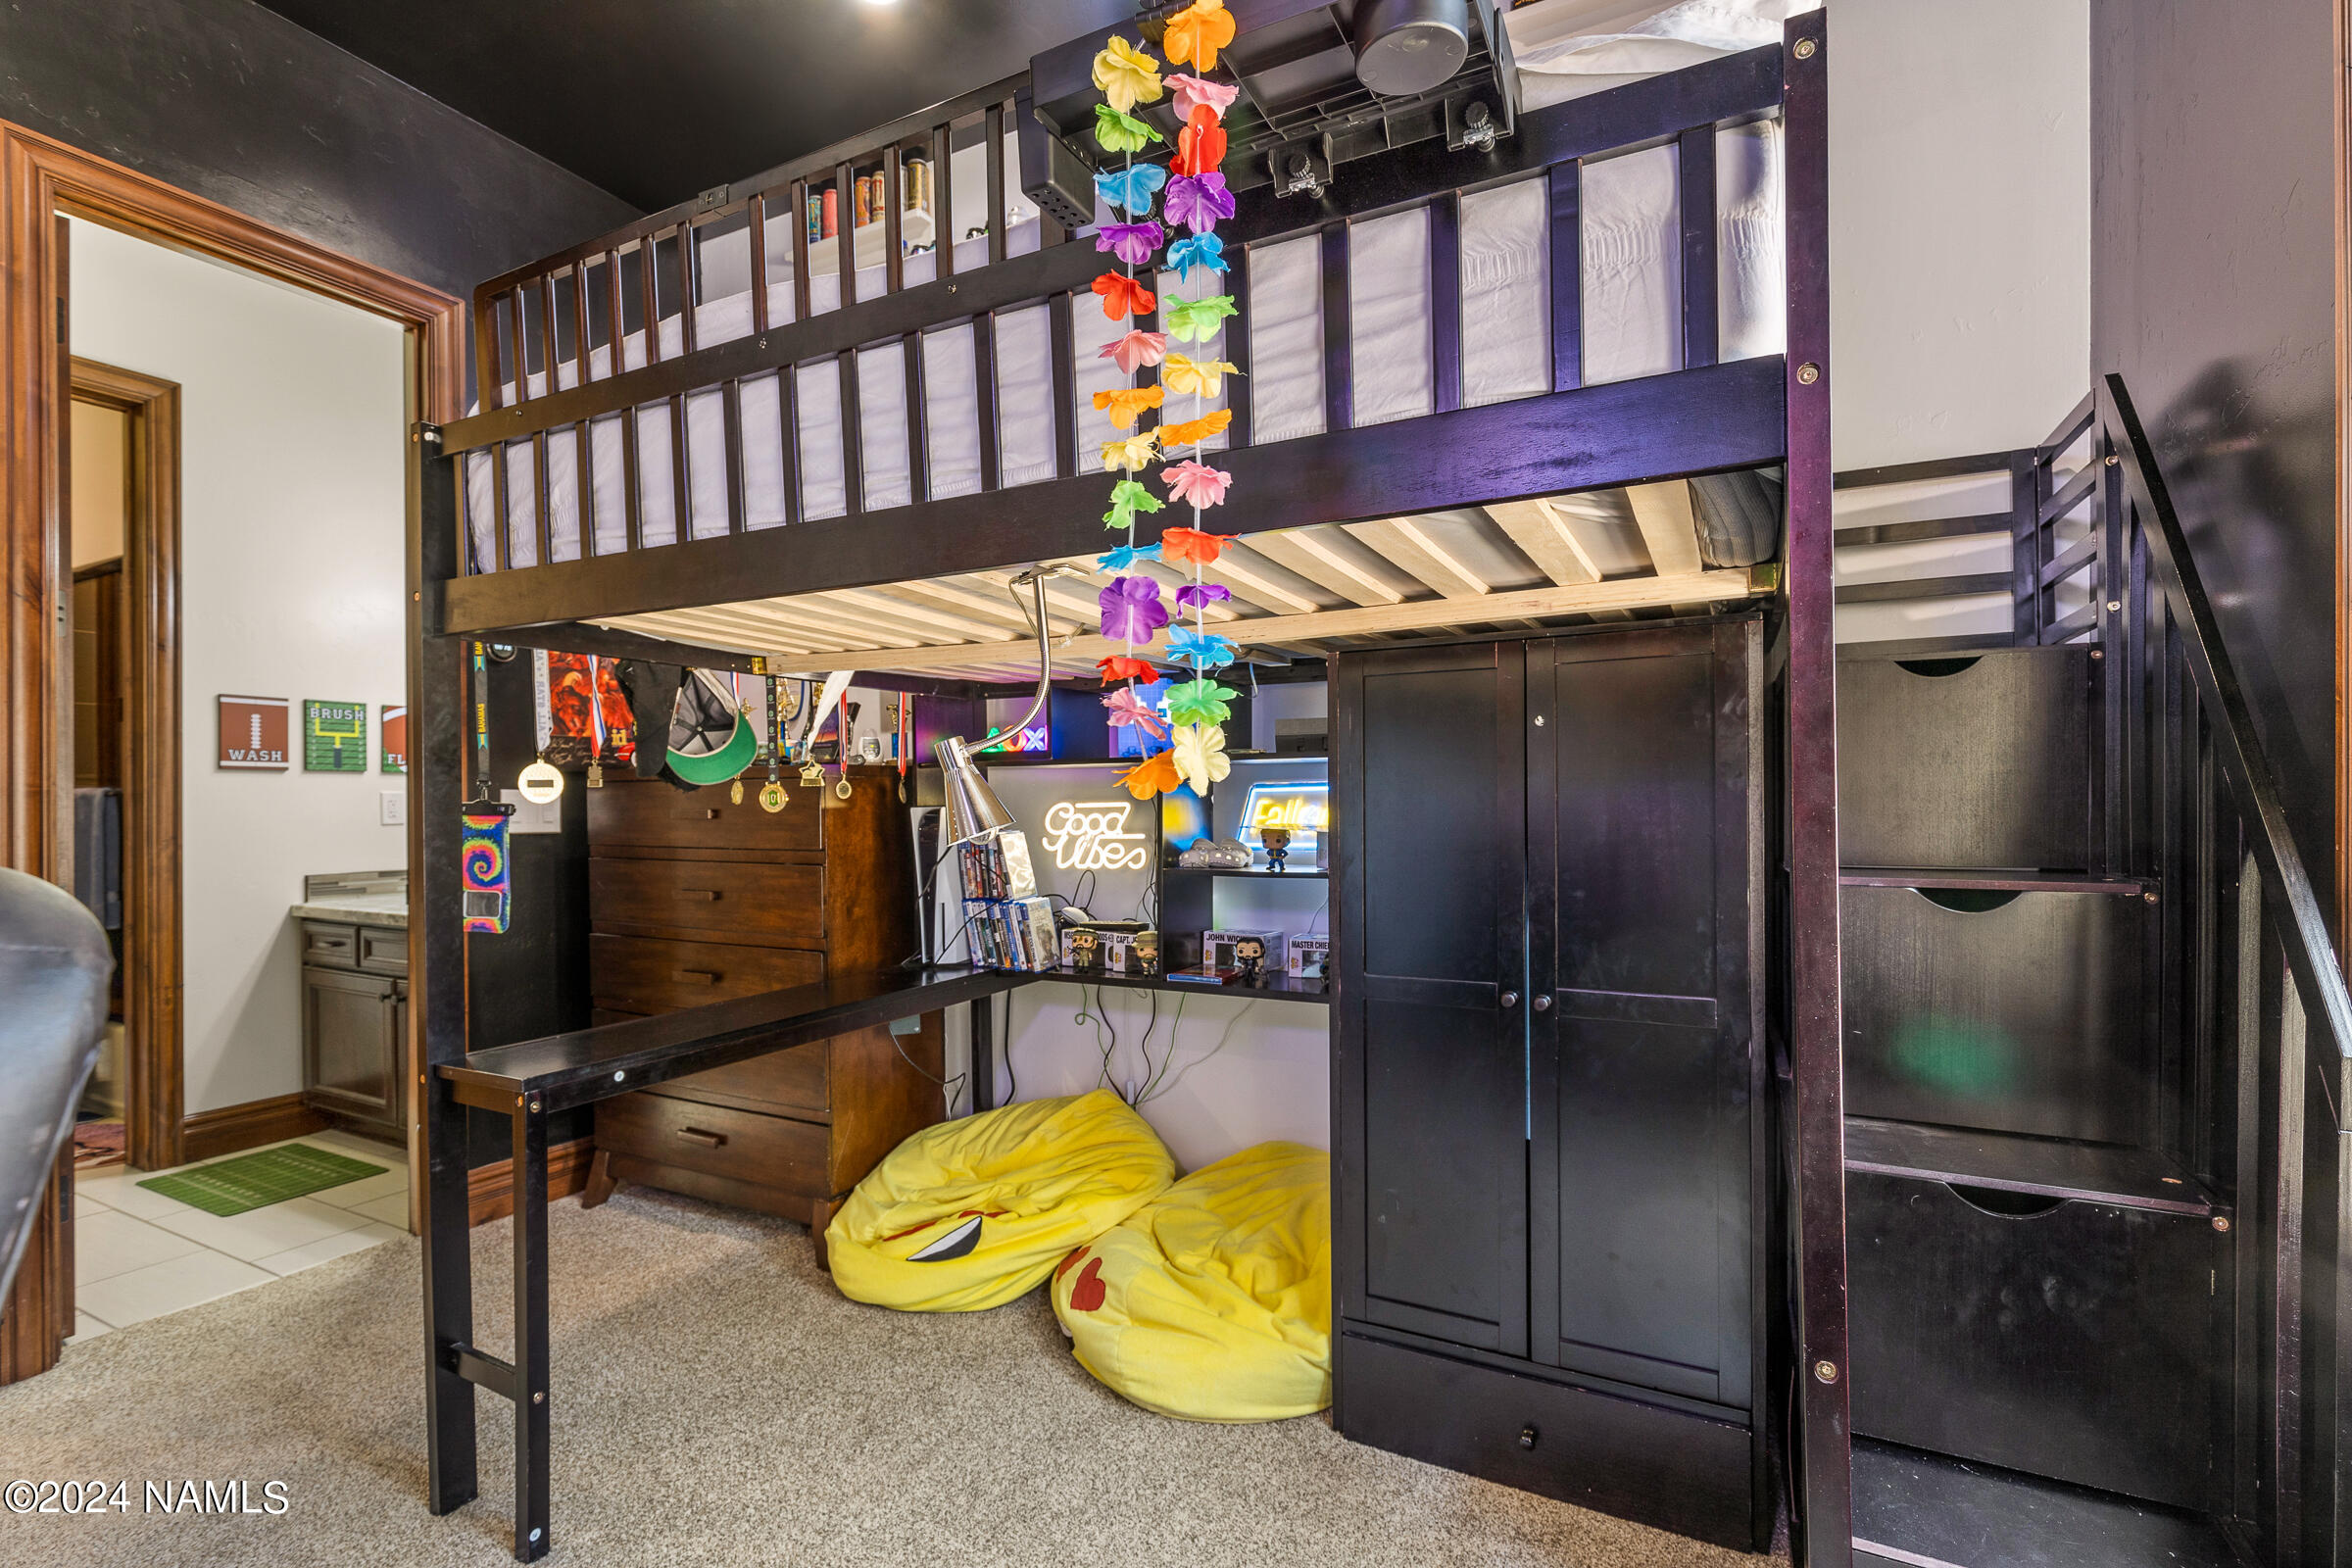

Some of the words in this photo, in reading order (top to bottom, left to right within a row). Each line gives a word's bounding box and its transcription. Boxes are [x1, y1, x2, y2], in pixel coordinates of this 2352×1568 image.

[310, 708, 364, 720] BRUSH
[227, 749, 282, 761] WASH
[387, 754, 407, 764] FL
[1045, 802, 1131, 836] Good
[1042, 833, 1147, 869] Vibes
[1206, 933, 1224, 942] JOHN
[1292, 940, 1313, 950] MASTER
